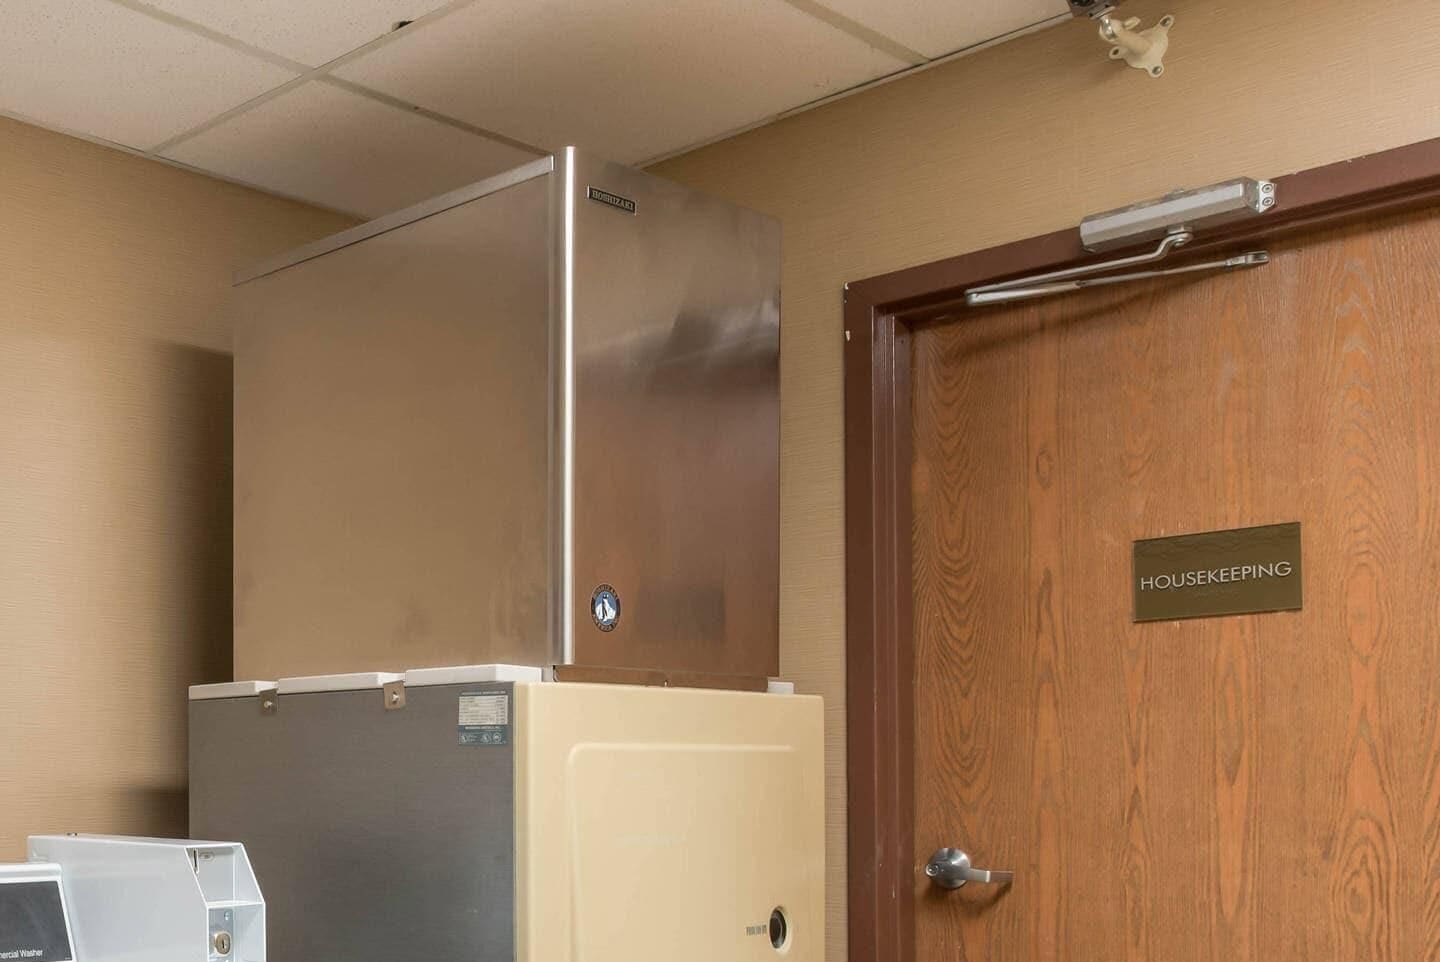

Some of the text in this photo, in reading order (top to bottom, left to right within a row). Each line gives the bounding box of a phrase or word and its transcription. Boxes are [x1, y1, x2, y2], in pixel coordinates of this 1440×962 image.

[591, 190, 634, 210] HOSHIZAKI
[1140, 561, 1293, 592] HOUSEKEEPING
[20, 949, 44, 958] Washer
